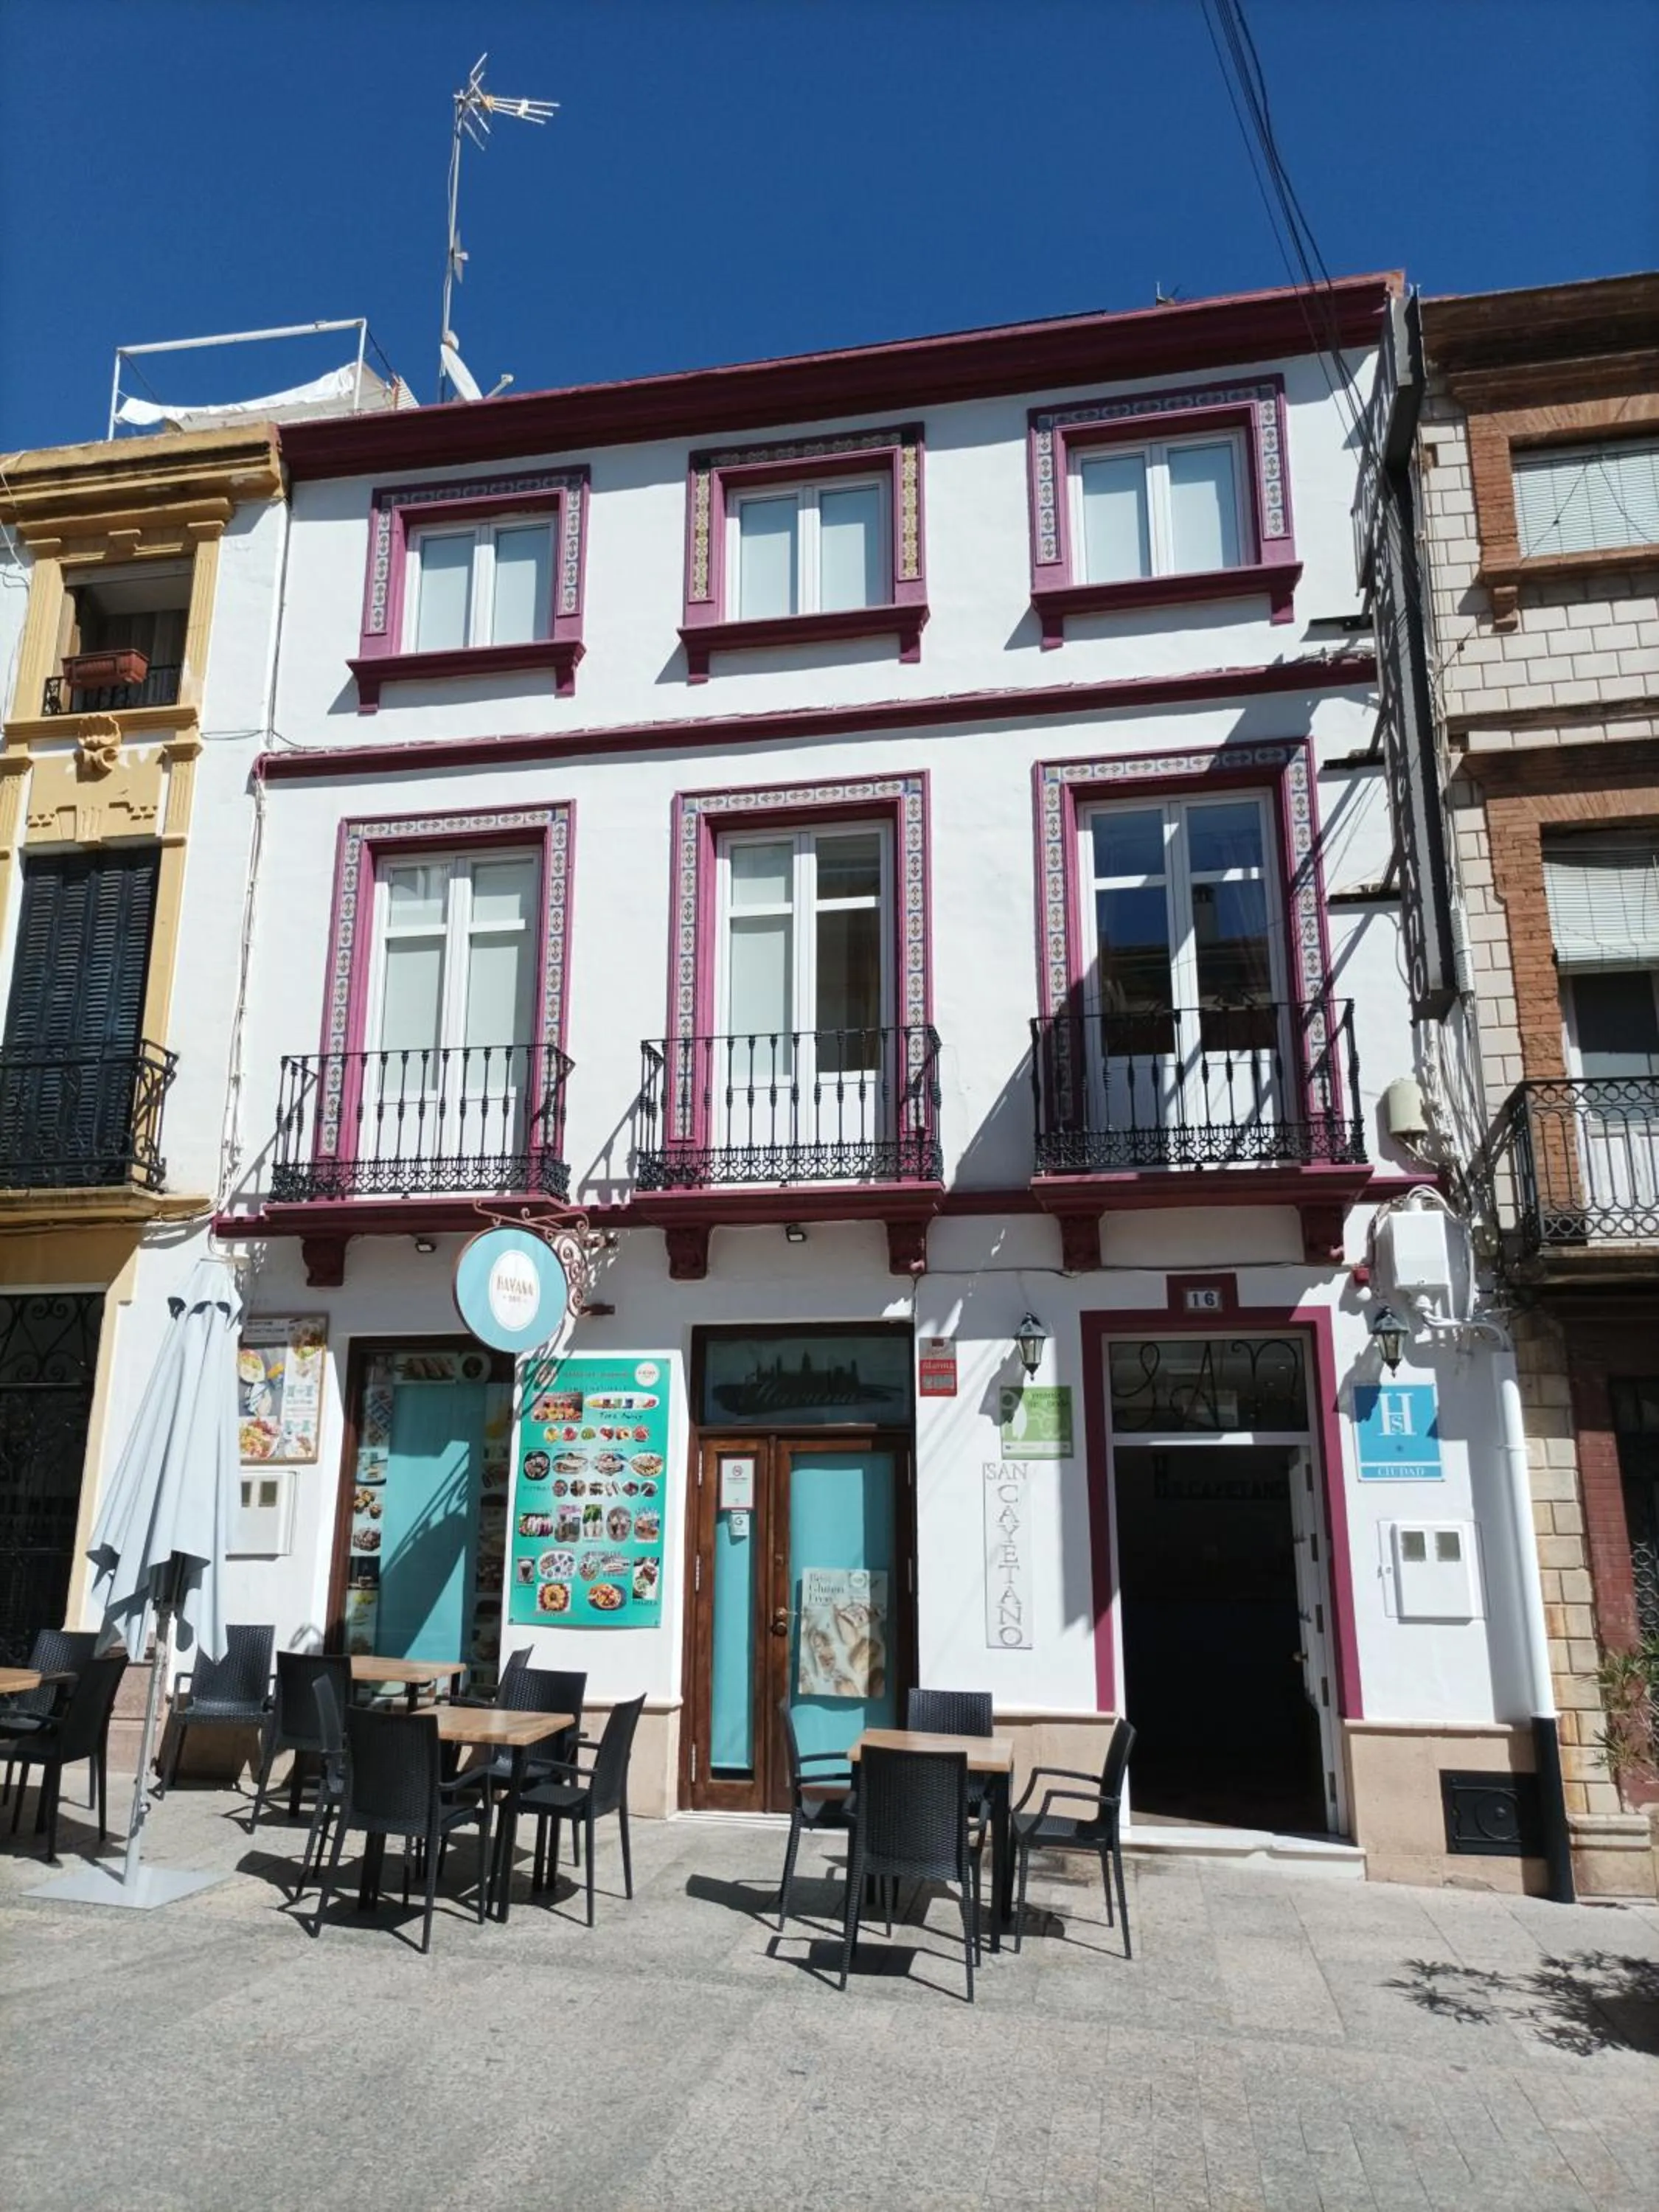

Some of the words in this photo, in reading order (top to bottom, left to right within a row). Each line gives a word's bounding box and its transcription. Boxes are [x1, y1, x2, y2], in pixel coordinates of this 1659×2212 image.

[1192, 1290, 1217, 1307] 16
[986, 1463, 1028, 1481] SAN
[1377, 1467, 1425, 1478] CIUDAD
[996, 1484, 1023, 1646] CAYETANO
